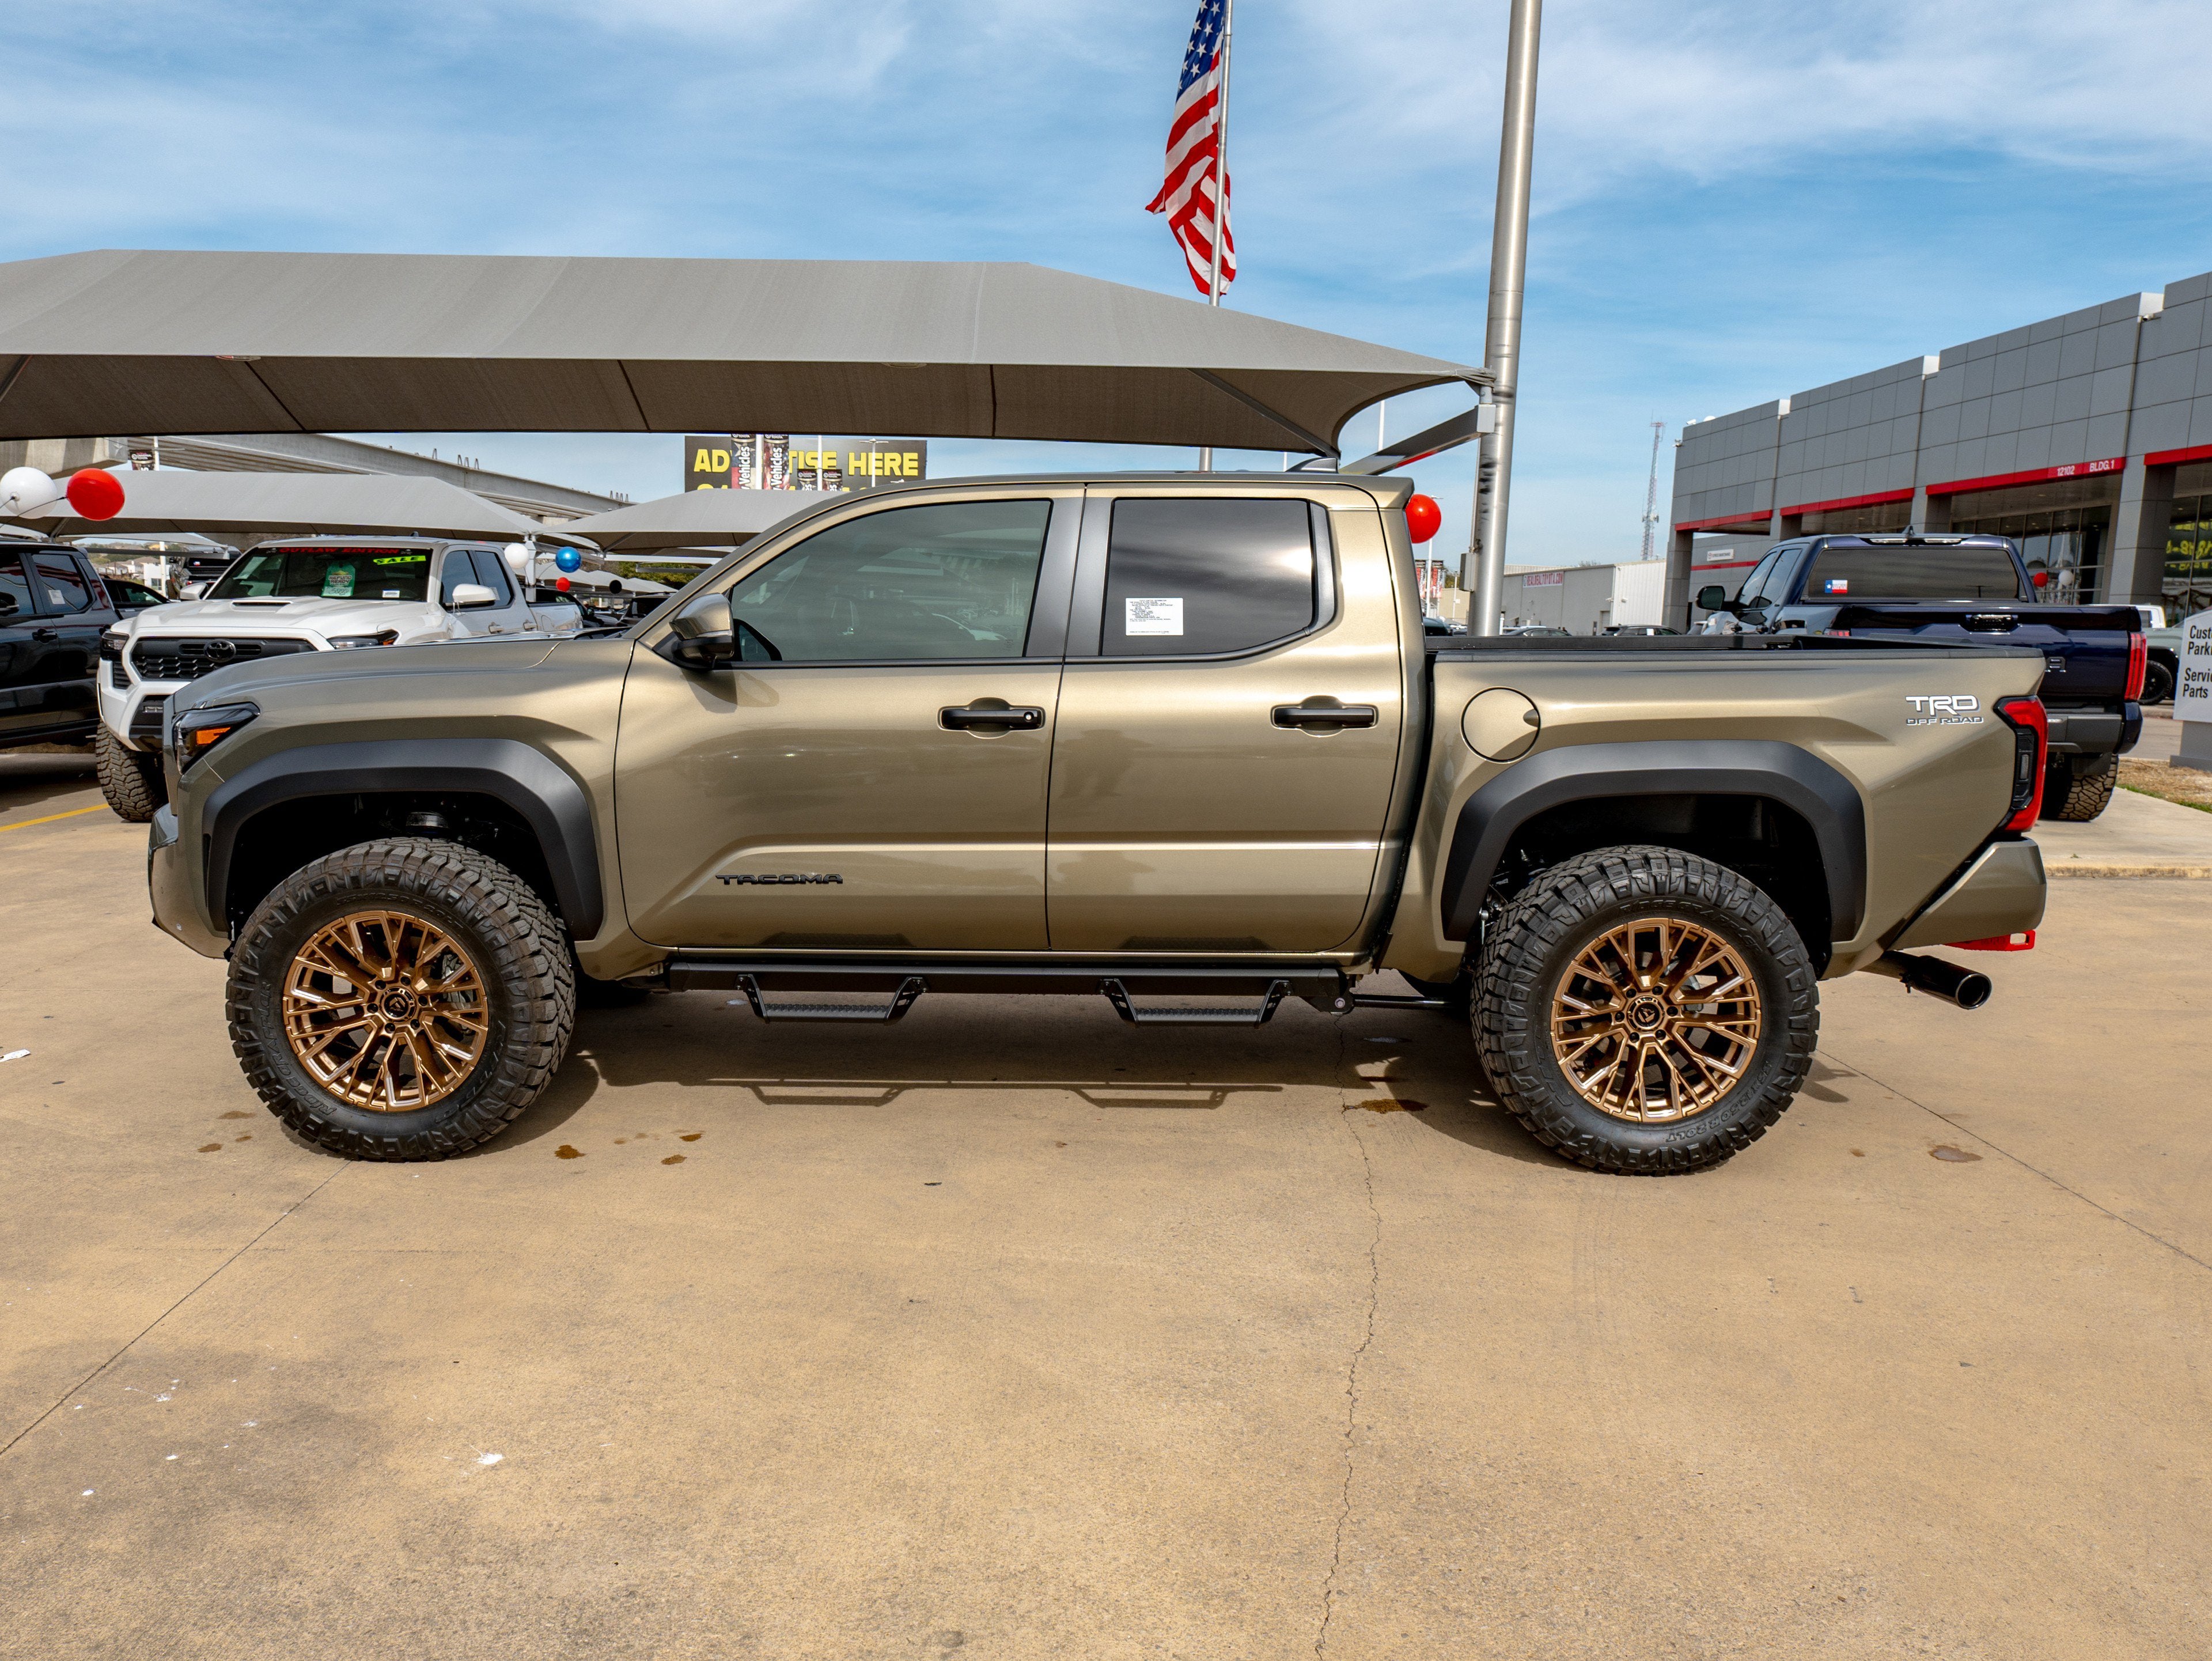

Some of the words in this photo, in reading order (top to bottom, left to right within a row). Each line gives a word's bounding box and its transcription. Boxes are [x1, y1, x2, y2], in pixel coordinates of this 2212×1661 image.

[694, 449, 837, 474] ADTISE
[848, 452, 919, 476] HERE
[738, 446, 751, 485] Vehicles
[770, 447, 783, 486] Vehicles
[2057, 466, 2075, 476] 12102
[375, 556, 421, 564] SALE
[2190, 625, 2212, 640] Cust
[2182, 684, 2209, 699] Parts
[1905, 695, 1979, 716] TRD
[1906, 718, 1938, 726] OFF
[1939, 716, 1984, 725] ROAD
[715, 873, 844, 886] TACOMA
